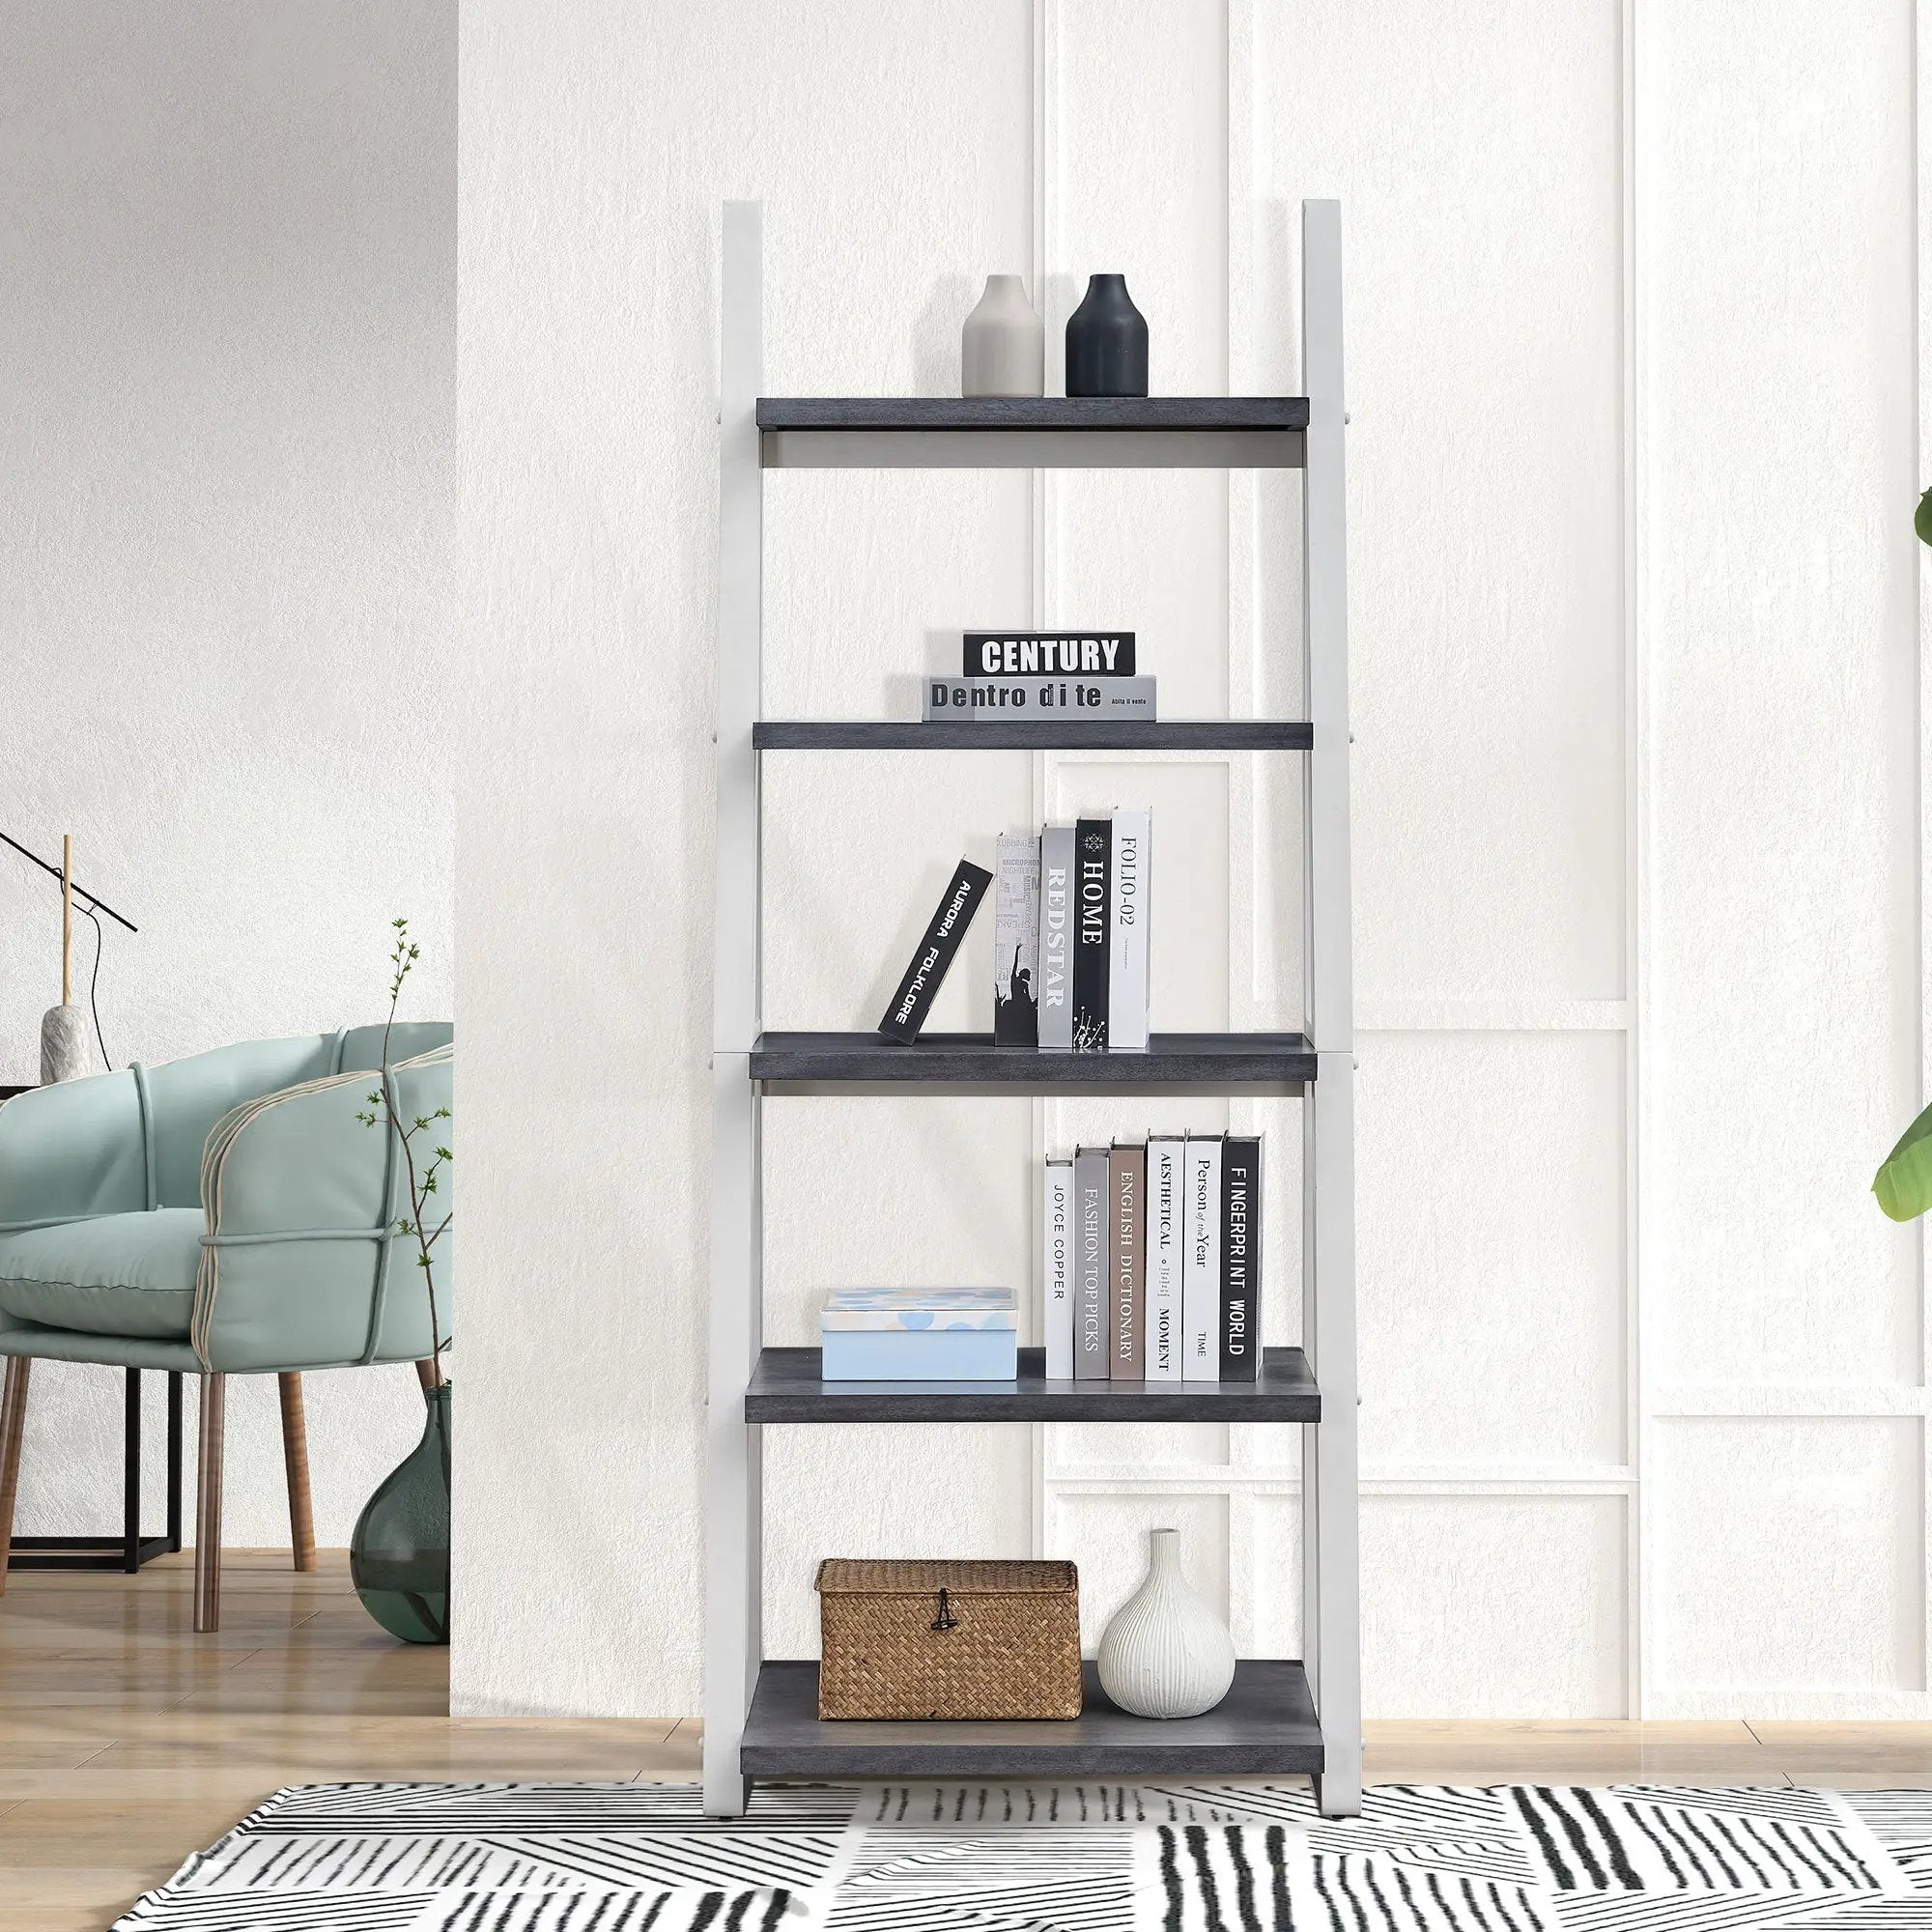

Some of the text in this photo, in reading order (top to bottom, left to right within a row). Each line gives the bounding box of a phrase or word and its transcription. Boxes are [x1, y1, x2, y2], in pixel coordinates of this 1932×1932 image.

[931, 684, 1026, 708] Dentro
[1075, 684, 1102, 707] te
[981, 639, 1120, 673] CENTURY
[1082, 860, 1105, 945] HOME
[1119, 837, 1137, 926] FOLIO-02
[895, 880, 971, 1025] AURORA FOLKLORE
[1046, 867, 1067, 1009] REDSTAR
[1054, 1184, 1065, 1300] JOYCE COPPER
[1160, 1152, 1172, 1250] AESTHETICAL
[1195, 1159, 1211, 1268] Person of the Year
[1085, 1188, 1099, 1352] FASHION TOP PICKS
[1119, 1171, 1133, 1362] ENGLISH DICTIONARY
[1228, 1167, 1247, 1356] FINGERPRINT WORLD
[1158, 1308, 1170, 1371] MOMENT
[1197, 1331, 1207, 1357] TIME
